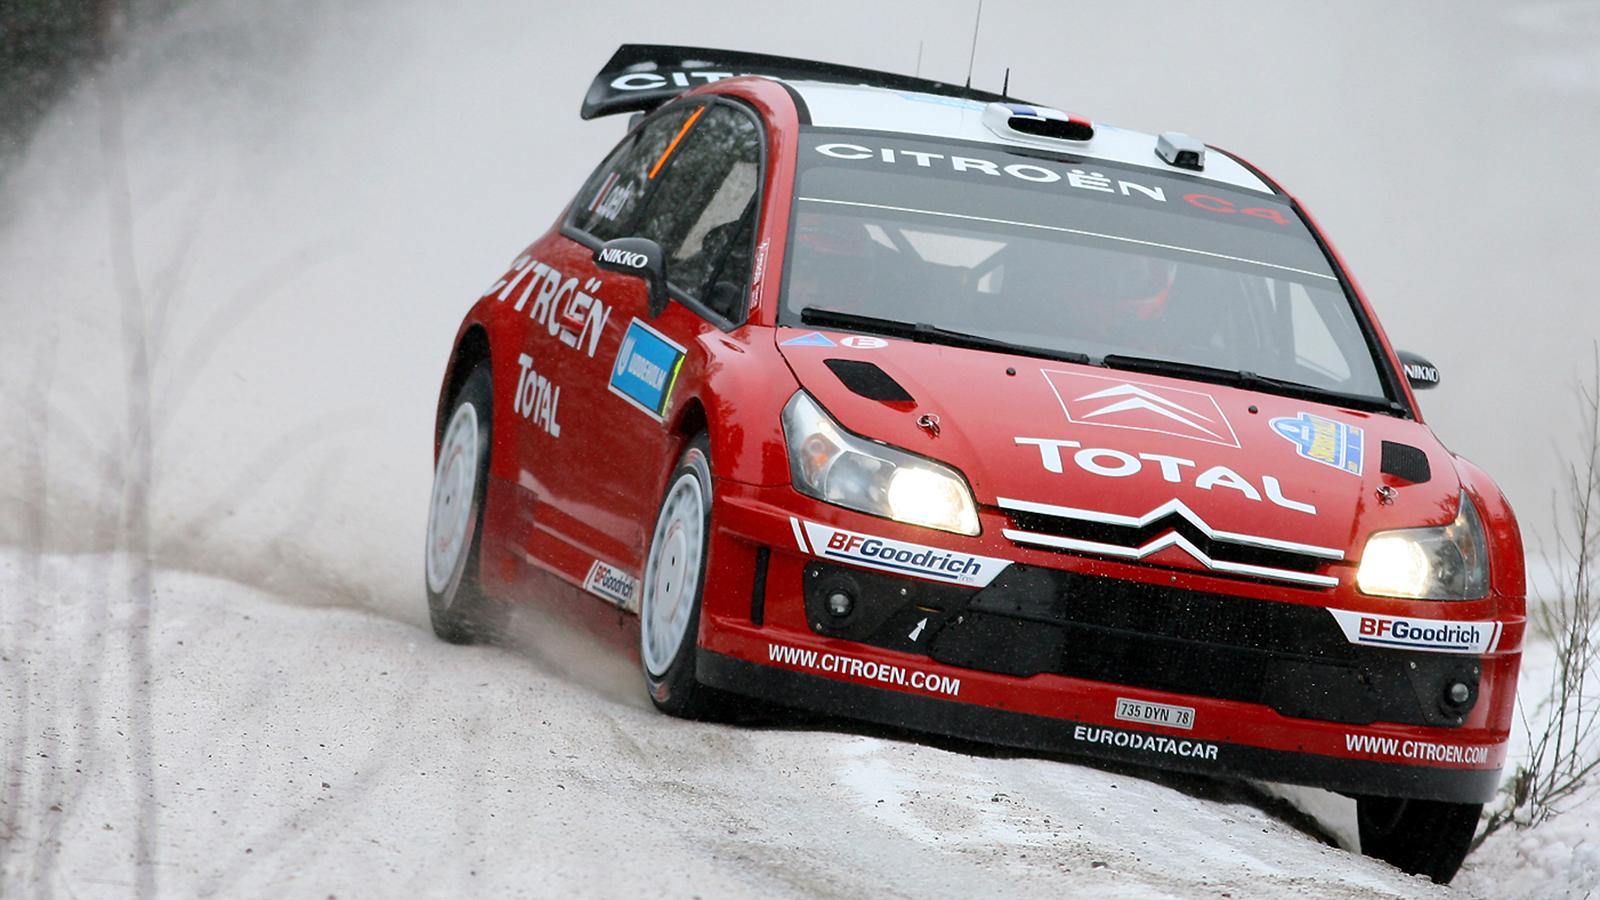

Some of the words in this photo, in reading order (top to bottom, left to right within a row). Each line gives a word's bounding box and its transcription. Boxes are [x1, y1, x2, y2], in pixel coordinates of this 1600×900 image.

[815, 142, 1167, 202] CITROËN
[1183, 192, 1291, 225] C4
[599, 248, 648, 268] NIKKO
[1403, 364, 1438, 382] NIKKO
[513, 352, 561, 438] TOTAL
[1014, 436, 1317, 515] TOTAL
[827, 531, 981, 576] BFGoodrich
[594, 565, 633, 599] BFGoodrich
[1359, 617, 1480, 644] BFGoodrich
[768, 643, 960, 696] WWW.CITROEN.COM
[1121, 702, 1141, 718] 735
[1144, 705, 1170, 722] DYN
[1176, 710, 1190, 725] 78
[1074, 725, 1219, 760] EURODATACAR
[1345, 734, 1488, 764] WWW.CITROEN.COM
